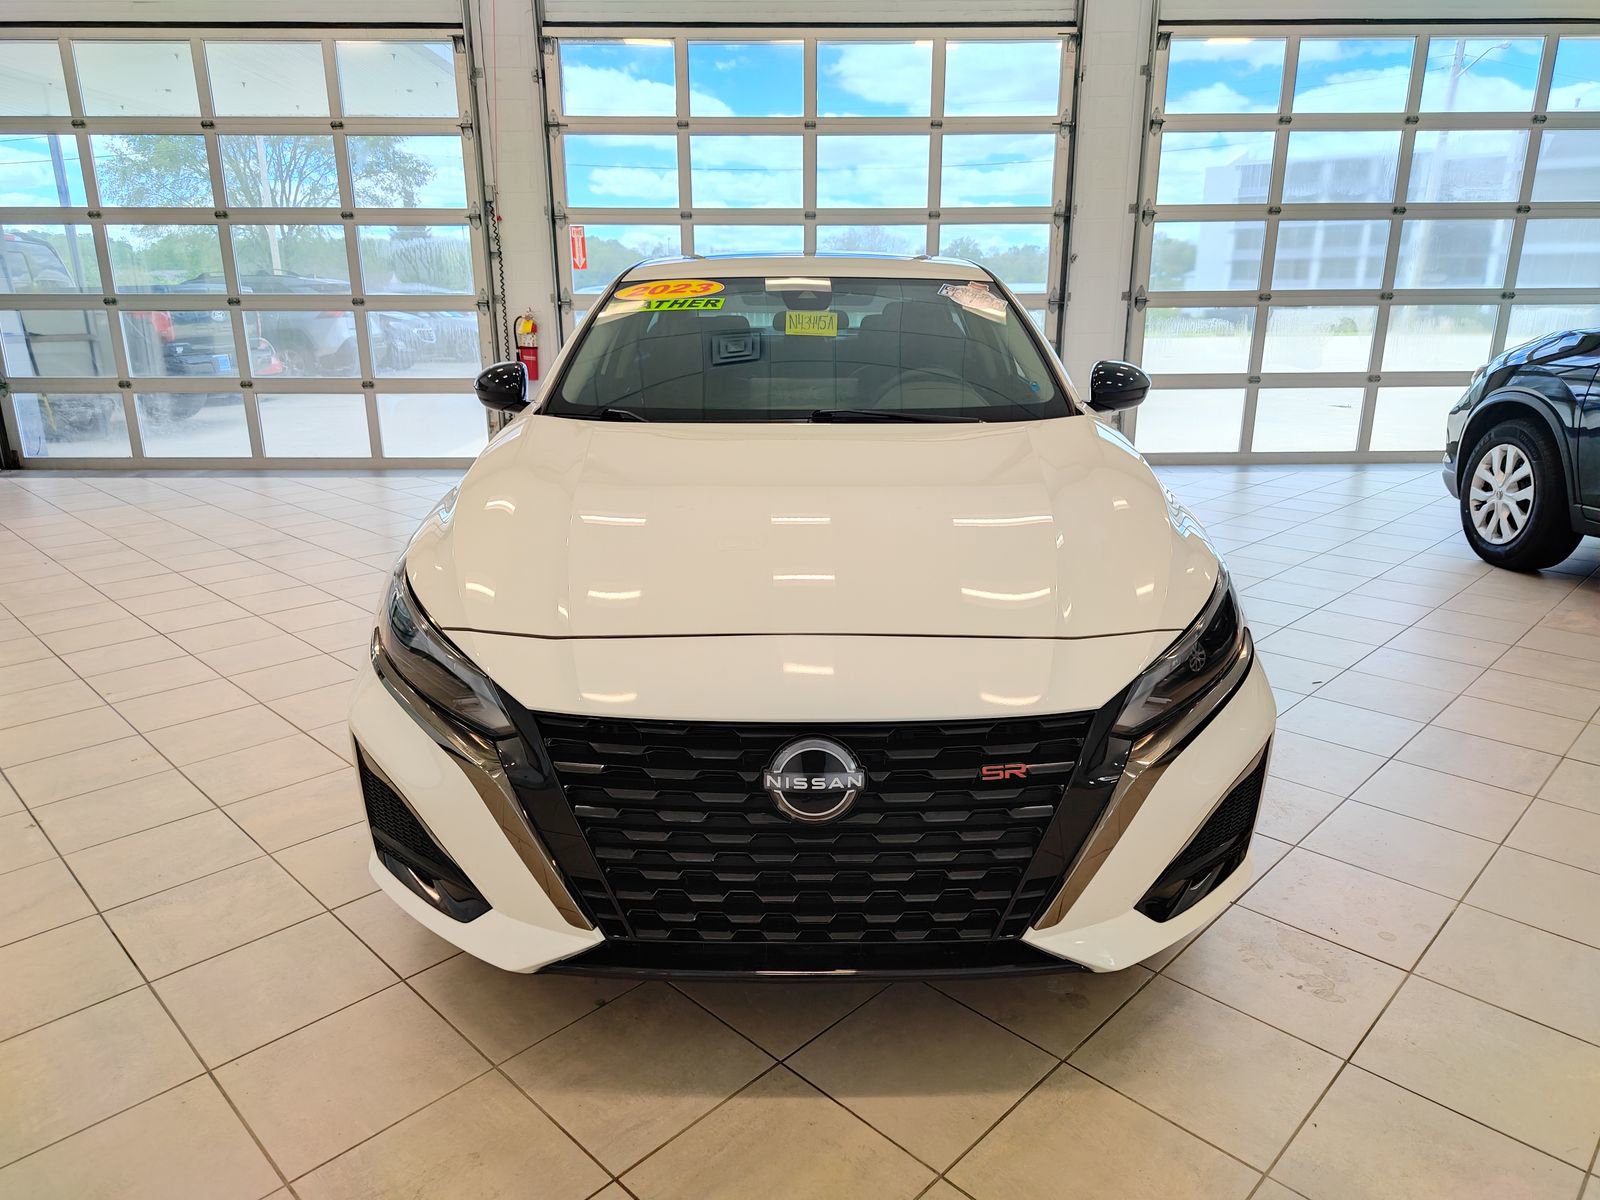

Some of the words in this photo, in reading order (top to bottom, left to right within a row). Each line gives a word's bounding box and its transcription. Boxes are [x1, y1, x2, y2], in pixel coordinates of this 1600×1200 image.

[626, 283, 714, 298] 2023
[981, 764, 1027, 780] SR
[766, 775, 862, 789] NISSAN
